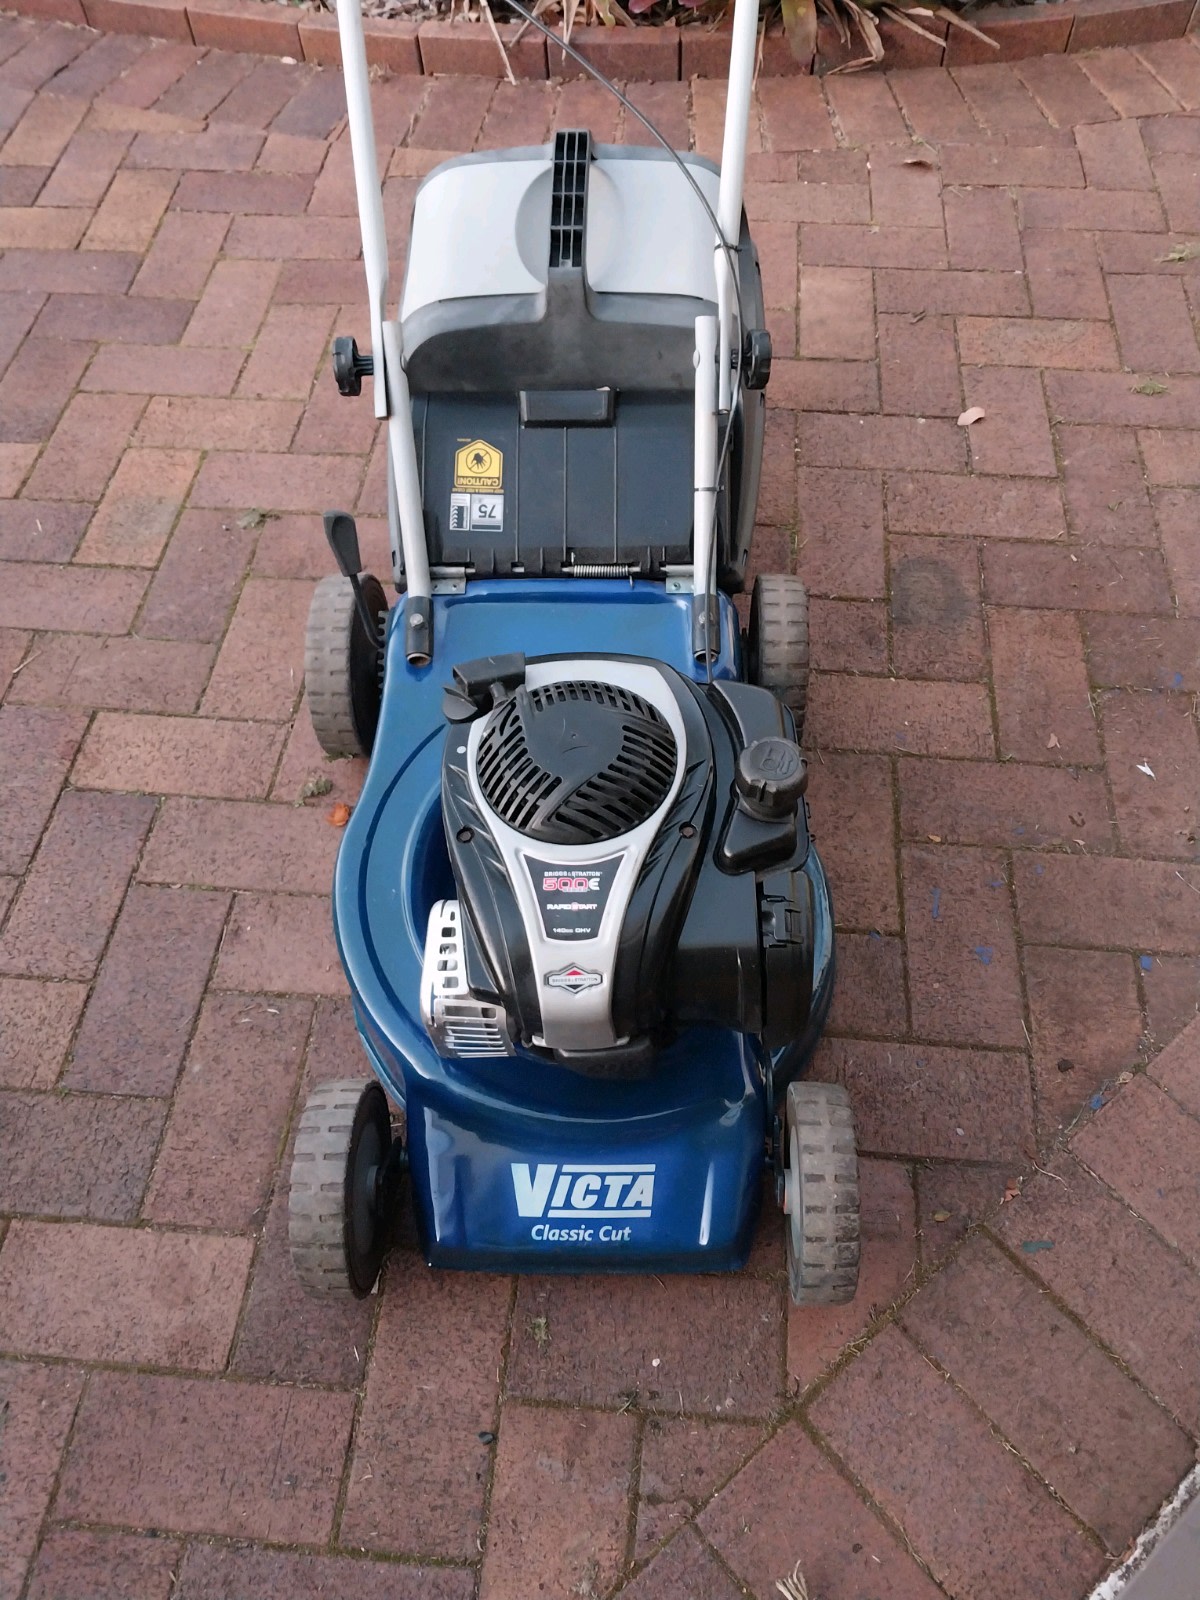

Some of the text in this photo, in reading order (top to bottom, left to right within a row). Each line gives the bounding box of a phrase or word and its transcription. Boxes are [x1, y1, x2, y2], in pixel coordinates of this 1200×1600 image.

[457, 477, 499, 486] CAUTION!
[478, 504, 497, 518] 75
[511, 1163, 655, 1217] VICTA
[531, 1225, 632, 1241] Classic Cut
